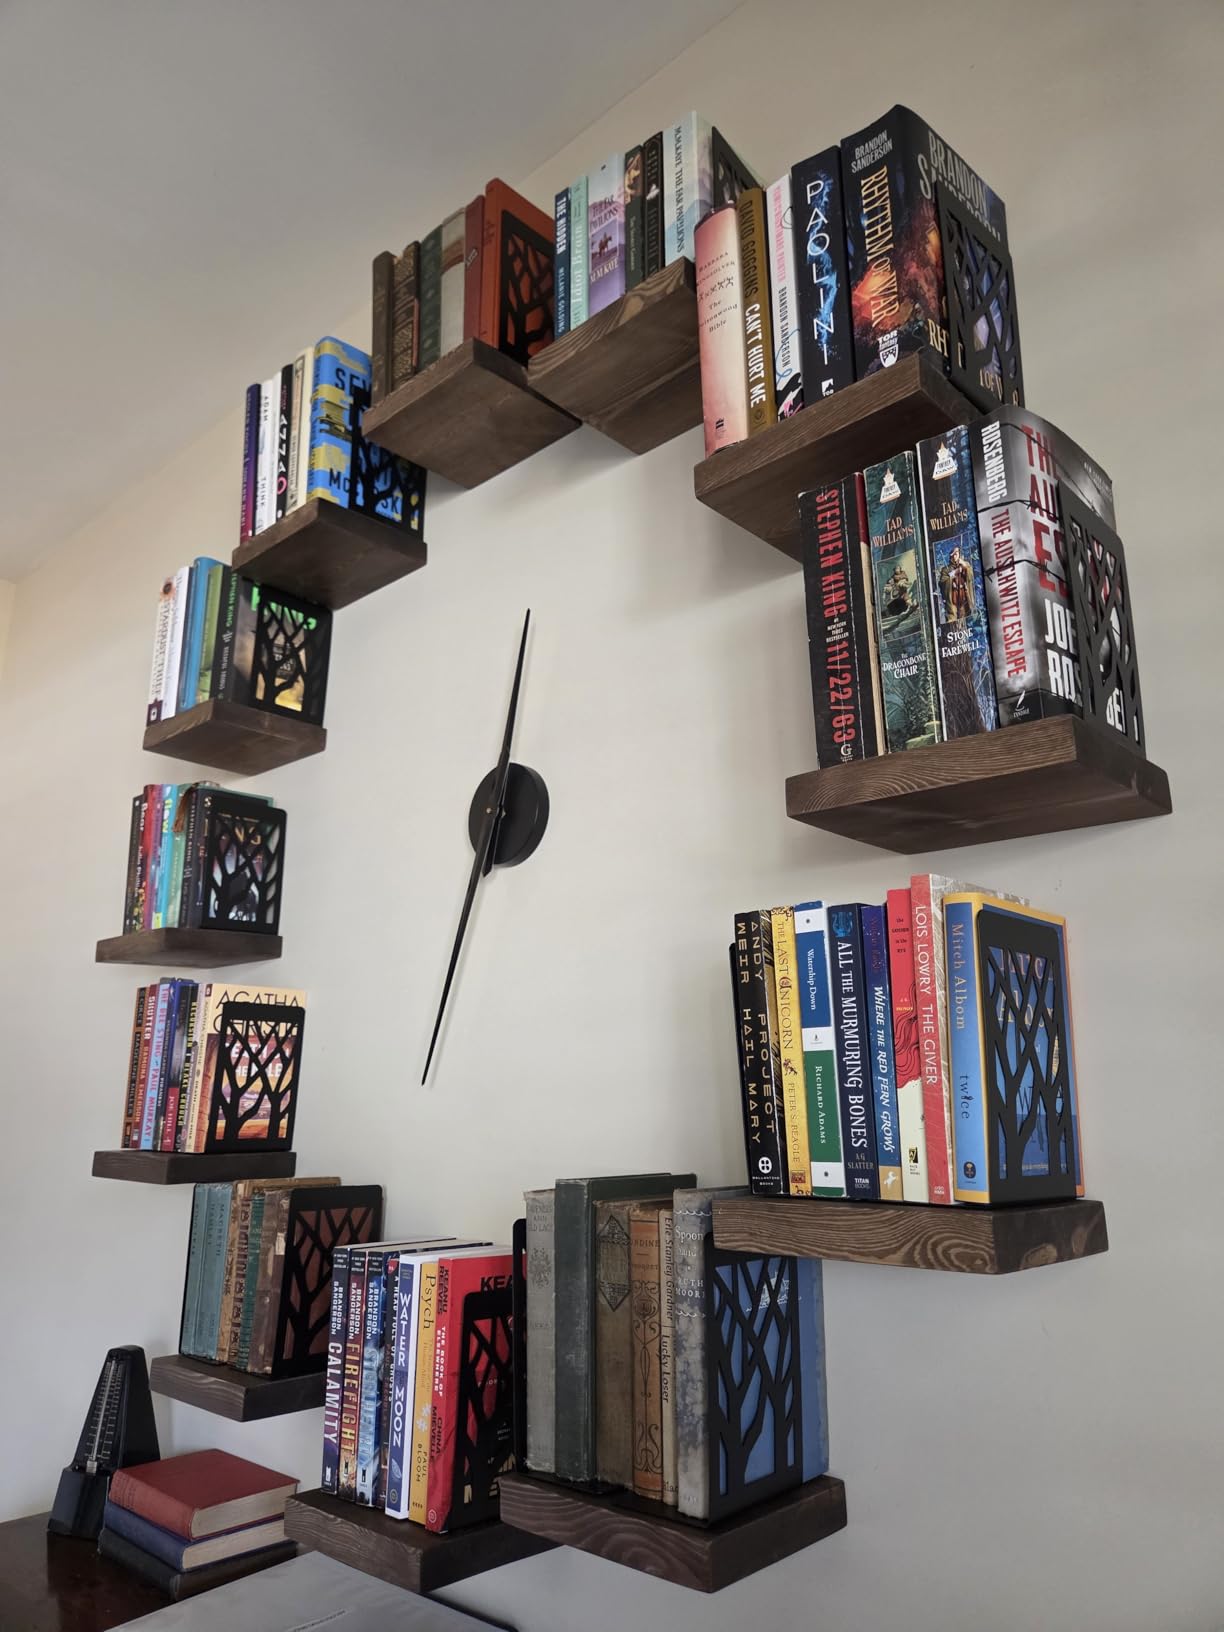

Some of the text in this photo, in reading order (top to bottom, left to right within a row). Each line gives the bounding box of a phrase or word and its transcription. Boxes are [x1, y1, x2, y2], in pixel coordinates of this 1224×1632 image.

[851, 139, 892, 173] SANDERSON
[854, 130, 888, 159] BRANDON
[928, 131, 987, 221] BRANDON
[556, 197, 567, 254] THE HIDDEN
[860, 166, 898, 328] RHYTHM OF WAR
[806, 180, 834, 365] PAOLINI
[709, 319, 726, 333] Bible
[739, 199, 766, 407] DAVID GOGGINS CAN'T HURT ME
[778, 287, 791, 367] BRANDON SANDERSON
[878, 330, 898, 344] TOR
[872, 524, 914, 548] WILLIAMS
[886, 516, 902, 532] TAD
[930, 508, 968, 531] WILLIAMS
[941, 500, 957, 516] TAD
[816, 489, 847, 618] STEPHEN KING
[981, 421, 1026, 678] ROSENBERG THE AUSCHWITZ ESCAPE
[883, 652, 928, 672] DRAGONBONE
[941, 642, 981, 658] FAREWELL
[946, 628, 973, 643] STONE
[826, 640, 855, 744] 11/22/63
[894, 665, 918, 679] CHAIR
[737, 922, 749, 984] WEIR
[752, 922, 764, 981] ANDY
[777, 940, 790, 976] LAST
[952, 923, 966, 1030] Mitch Albom
[216, 990, 298, 1008] AGATHA
[779, 976, 793, 1050] UNICORN
[916, 906, 938, 1086] LOIS LOWRY THE GIVER
[156, 1028, 164, 1058] STING
[187, 1002, 197, 1048] RECURSION
[838, 942, 868, 1148] ALL THE MURMURING BONES
[135, 996, 156, 1123] SHUTTER RAMONA EMERSON
[152, 1068, 160, 1092] PAUL
[182, 1061, 190, 1092] BLAKE
[743, 1008, 760, 1144] HAIL MARY
[758, 1013, 774, 1134] PROJECT
[874, 986, 895, 1152] WHERE THE RED FERN GROWS
[127, 1083, 135, 1117] MILLER
[145, 1096, 156, 1138] MURRAY
[177, 1093, 186, 1127] CROUCH
[788, 1082, 800, 1164] PETER BEAGLE
[815, 1066, 826, 1144] RICHARD ADAMS
[960, 1075, 970, 1120] twice
[848, 1162, 874, 1170] SLATTER
[216, 1204, 224, 1256] MACBETH
[675, 1225, 704, 1243] Spoon
[664, 1217, 674, 1320] Erle Stanley Gardner
[678, 1277, 704, 1287] RUTH
[331, 1281, 339, 1335] SANDERSON
[366, 1282, 374, 1339] SANDERSON
[421, 1273, 436, 1330] Psych
[324, 1342, 342, 1444] CALAMITY
[393, 1294, 411, 1447] WATER MOON
[660, 1333, 670, 1403] Lucky Loser
[342, 1343, 360, 1456] FIREFIGHT
